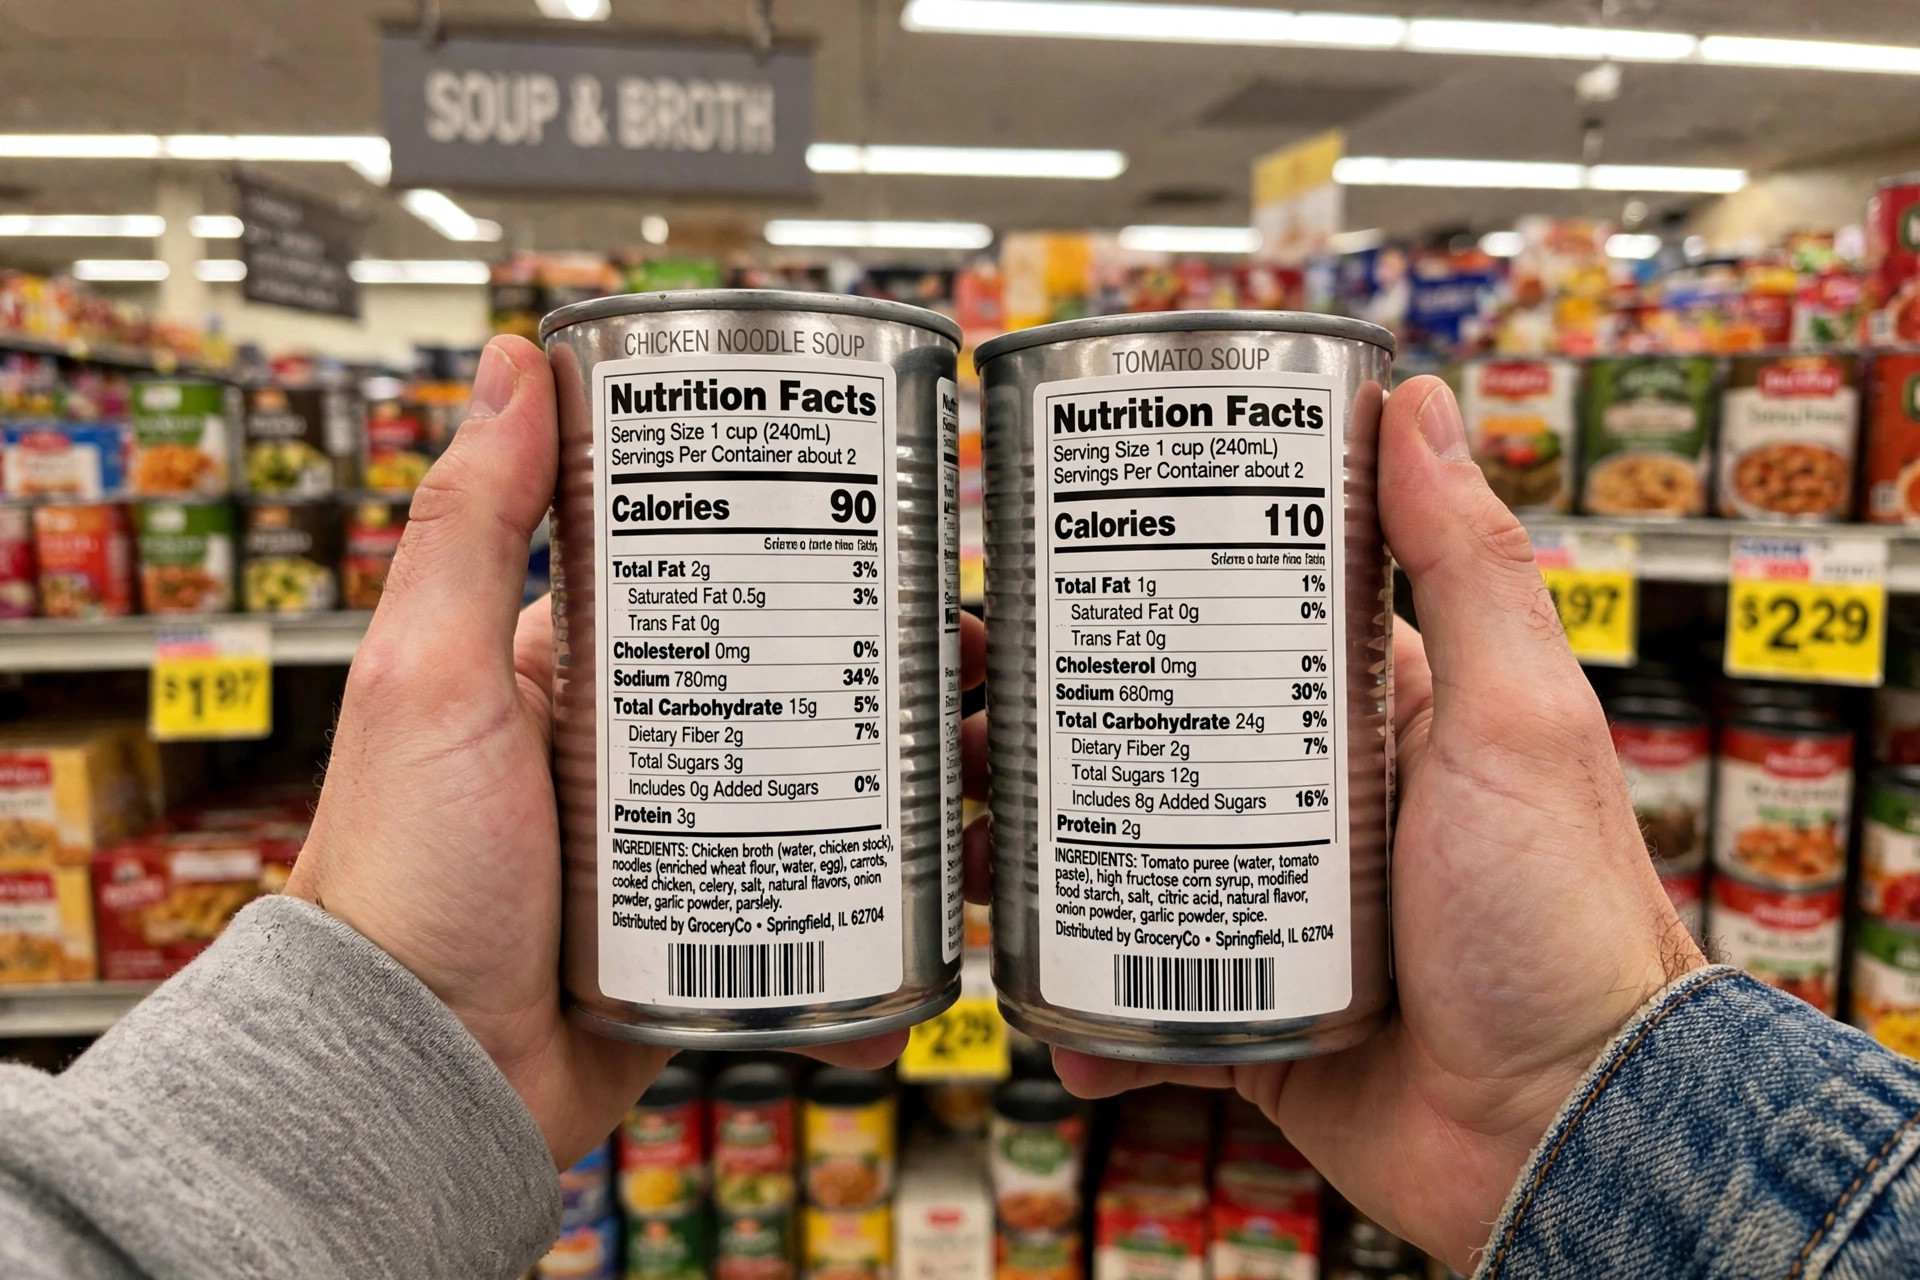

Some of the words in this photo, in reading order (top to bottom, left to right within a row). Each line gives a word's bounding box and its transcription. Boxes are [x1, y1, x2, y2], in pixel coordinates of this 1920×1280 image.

[424, 68, 560, 146] SOUP
[567, 72, 610, 150] &
[617, 76, 775, 155] BROTH
[625, 330, 709, 355] CHICKEN
[718, 329, 804, 352] NOODLE
[812, 332, 864, 356] SOUP
[1112, 348, 1204, 374] TOMATO
[1211, 348, 1269, 370] SOUP
[611, 378, 766, 415] Nutrition
[780, 379, 876, 416] Facts
[1054, 396, 1213, 434] Nutrition
[1227, 395, 1323, 429] Facts
[611, 424, 665, 446] Serving
[670, 422, 704, 441] Size
[711, 422, 718, 439] 1
[726, 426, 758, 444] cup
[763, 422, 830, 446] (240mL)
[612, 447, 674, 468] Servings
[679, 445, 707, 463] Per
[711, 445, 793, 463] Container
[797, 446, 843, 465] about
[847, 448, 856, 465] 2
[1053, 443, 1110, 464] Serving
[1115, 440, 1150, 458] Size
[1156, 439, 1163, 456] 1
[1171, 442, 1204, 460] cup
[1210, 437, 1278, 460] (240mL)
[1054, 465, 1119, 486] Servings
[1124, 463, 1152, 480] Per
[1157, 460, 1240, 479] Container
[1244, 460, 1290, 478] about
[1294, 461, 1304, 479] 2
[612, 492, 730, 522] Calories
[830, 489, 876, 524] 90
[1054, 509, 1176, 540] Calories
[1265, 503, 1324, 537] 110
[612, 560, 652, 578] Total
[658, 560, 686, 578] Fat
[691, 560, 710, 581] 2g
[852, 561, 878, 578] 3%
[628, 587, 698, 605] Saturated
[703, 587, 728, 604] Fat
[732, 587, 766, 608] 0.5g
[853, 587, 878, 605] 3%
[1055, 577, 1096, 594] Total
[1102, 576, 1131, 594] Fat
[1138, 576, 1156, 597] 1g
[1302, 574, 1325, 592] 1%
[628, 614, 667, 631] Trans
[672, 614, 696, 631] Fat
[700, 614, 719, 635] 0g
[1071, 603, 1143, 620] Saturated
[1149, 603, 1174, 620] Fat
[1179, 603, 1199, 624] 0g
[1300, 601, 1326, 619] 0%
[613, 641, 710, 660] Cholesterol
[715, 642, 750, 663] 0mg
[853, 640, 879, 658] 0%
[1071, 630, 1112, 646] Trans
[1117, 630, 1141, 646] Fat
[1146, 630, 1166, 650] 0g
[1056, 656, 1155, 674] Cholesterol
[1161, 657, 1197, 678] 0mg
[1301, 655, 1327, 672] 0%
[614, 669, 670, 687] Sodium
[674, 671, 727, 692] 780mg
[843, 667, 879, 686] 34%
[1056, 683, 1114, 701] Sodium
[1119, 685, 1173, 706] 680mg
[1291, 682, 1327, 701] 30%
[613, 697, 653, 715] Total
[658, 698, 783, 720] Carbohydrate
[789, 698, 817, 718] 15g
[854, 695, 879, 713] 5%
[1056, 710, 1097, 729] Total
[1102, 712, 1230, 734] Carbohydrate
[1236, 712, 1264, 733] 24g
[1302, 710, 1327, 728] 9%
[629, 725, 677, 747] Dietary
[682, 726, 720, 743] Fiber
[724, 726, 743, 748] 2g
[854, 722, 879, 740] 7%
[1072, 738, 1122, 760] Dietary
[1127, 739, 1166, 756] Fiber
[1170, 740, 1190, 761] 2g
[1303, 737, 1328, 755] 7%
[629, 752, 662, 769] Total
[667, 753, 719, 775] Sugars
[724, 753, 743, 774] 3g
[1071, 764, 1107, 781] Total
[1112, 765, 1165, 787] Sugars
[1171, 767, 1199, 788] 12g
[629, 778, 686, 797] Includes
[690, 780, 708, 801] 0g
[713, 780, 762, 797] Added
[767, 779, 819, 800] Sugars
[854, 774, 880, 793] 0%
[1073, 789, 1130, 808] Includes
[1135, 792, 1154, 813] 8g
[1159, 793, 1209, 810] Added
[1214, 793, 1267, 814] Sugars
[1295, 789, 1329, 807] 16%
[615, 804, 672, 824] Protein
[677, 807, 695, 829] 3g
[1057, 814, 1116, 835] Protein
[1122, 819, 1141, 840] 2g
[612, 838, 688, 857] INGREDIENTS:
[691, 842, 739, 858] Chicken
[742, 842, 774, 858] broth
[778, 842, 816, 860] (water,
[819, 839, 860, 855] chicken
[862, 834, 894, 853] stock),
[612, 857, 652, 873] noodles
[655, 858, 707, 878] (enriched
[710, 860, 746, 875] wheat
[749, 859, 779, 876] flour,
[782, 859, 817, 874] water,
[820, 856, 847, 875] egg),
[850, 853, 887, 869] carrots,
[1055, 847, 1137, 868] INGREDIENTS:
[1141, 853, 1189, 870] Tomato
[1193, 859, 1230, 873] puree
[1233, 854, 1275, 873] (water,
[1279, 853, 1319, 868] tomato
[1055, 867, 1093, 884] paste),
[1097, 868, 1122, 888] high
[1126, 870, 1179, 887] fructose
[1182, 876, 1212, 887] corn
[1215, 875, 1254, 891] syrup,
[1257, 868, 1308, 886] modified
[612, 911, 667, 931] Distributed
[670, 915, 685, 936] by
[687, 916, 752, 937] GroceryCo
[767, 912, 835, 936] Springfield,
[838, 911, 848, 927] IL
[851, 906, 885, 926] 62704
[1055, 901, 1086, 917] onion
[1089, 905, 1136, 923] powder,
[1140, 906, 1174, 925] garlic
[1178, 907, 1228, 926] powder,
[1232, 907, 1267, 927] spice.
[1056, 920, 1113, 942] Distributed
[1117, 927, 1131, 947] by
[1134, 928, 1200, 950] GroceryCo
[1216, 928, 1284, 951] Springfield,
[1288, 927, 1299, 943] IL
[1301, 924, 1334, 943] 62704
